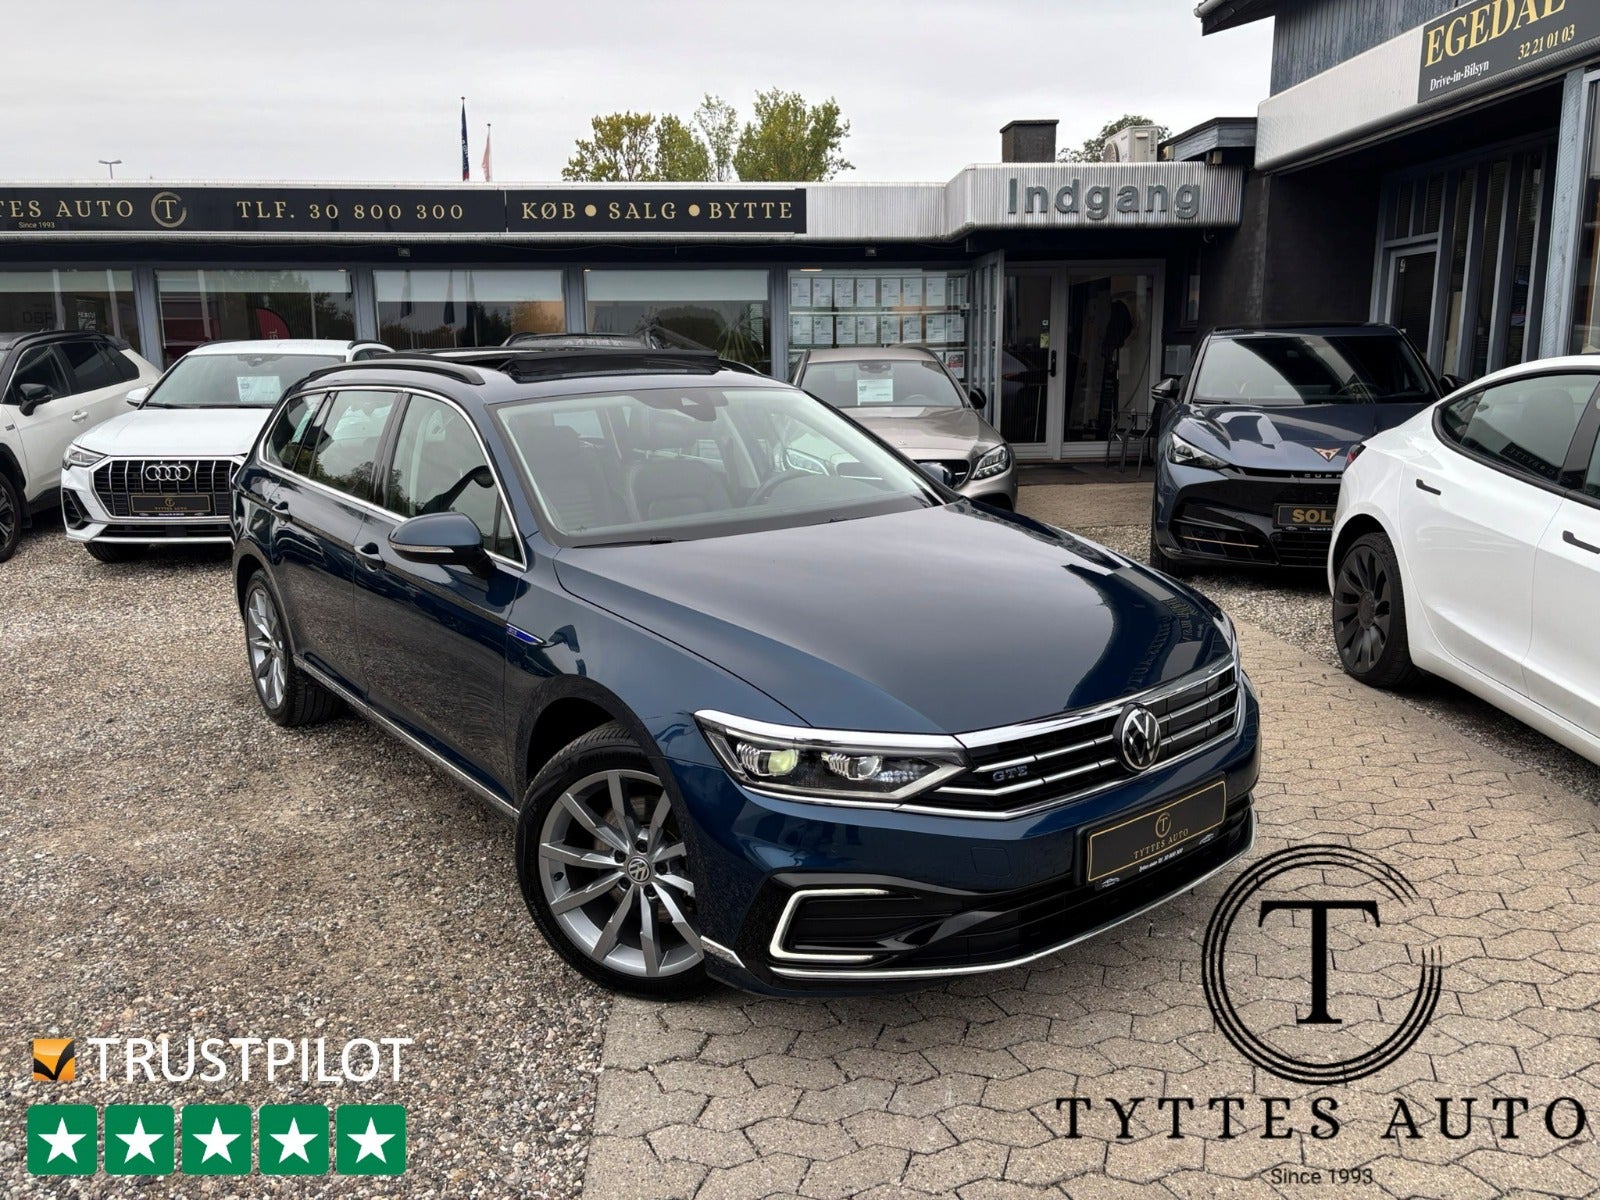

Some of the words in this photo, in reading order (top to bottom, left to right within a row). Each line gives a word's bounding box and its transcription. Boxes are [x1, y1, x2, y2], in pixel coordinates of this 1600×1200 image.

[1517, 42, 1530, 60] 32
[1531, 36, 1544, 55] 21
[1546, 30, 1559, 49] 01
[1561, 24, 1575, 43] 03
[1429, 60, 1490, 92] Drive-in-Bilsyn
[1008, 178, 1200, 220] Indgang
[56, 200, 134, 218] AUTO
[236, 200, 295, 219] TLF.
[309, 204, 339, 219] 30
[354, 204, 402, 219] 800
[416, 204, 463, 220] 300
[521, 202, 577, 220] KØB
[608, 202, 677, 220] SALG
[709, 202, 793, 220] BYTTE
[18, 221, 37, 229] Since
[38, 221, 55, 229] 1993
[1291, 508, 1336, 523] SOL
[992, 765, 1028, 782] GTE
[1133, 840, 1166, 860] TYTTES
[1167, 828, 1189, 845] AUTO
